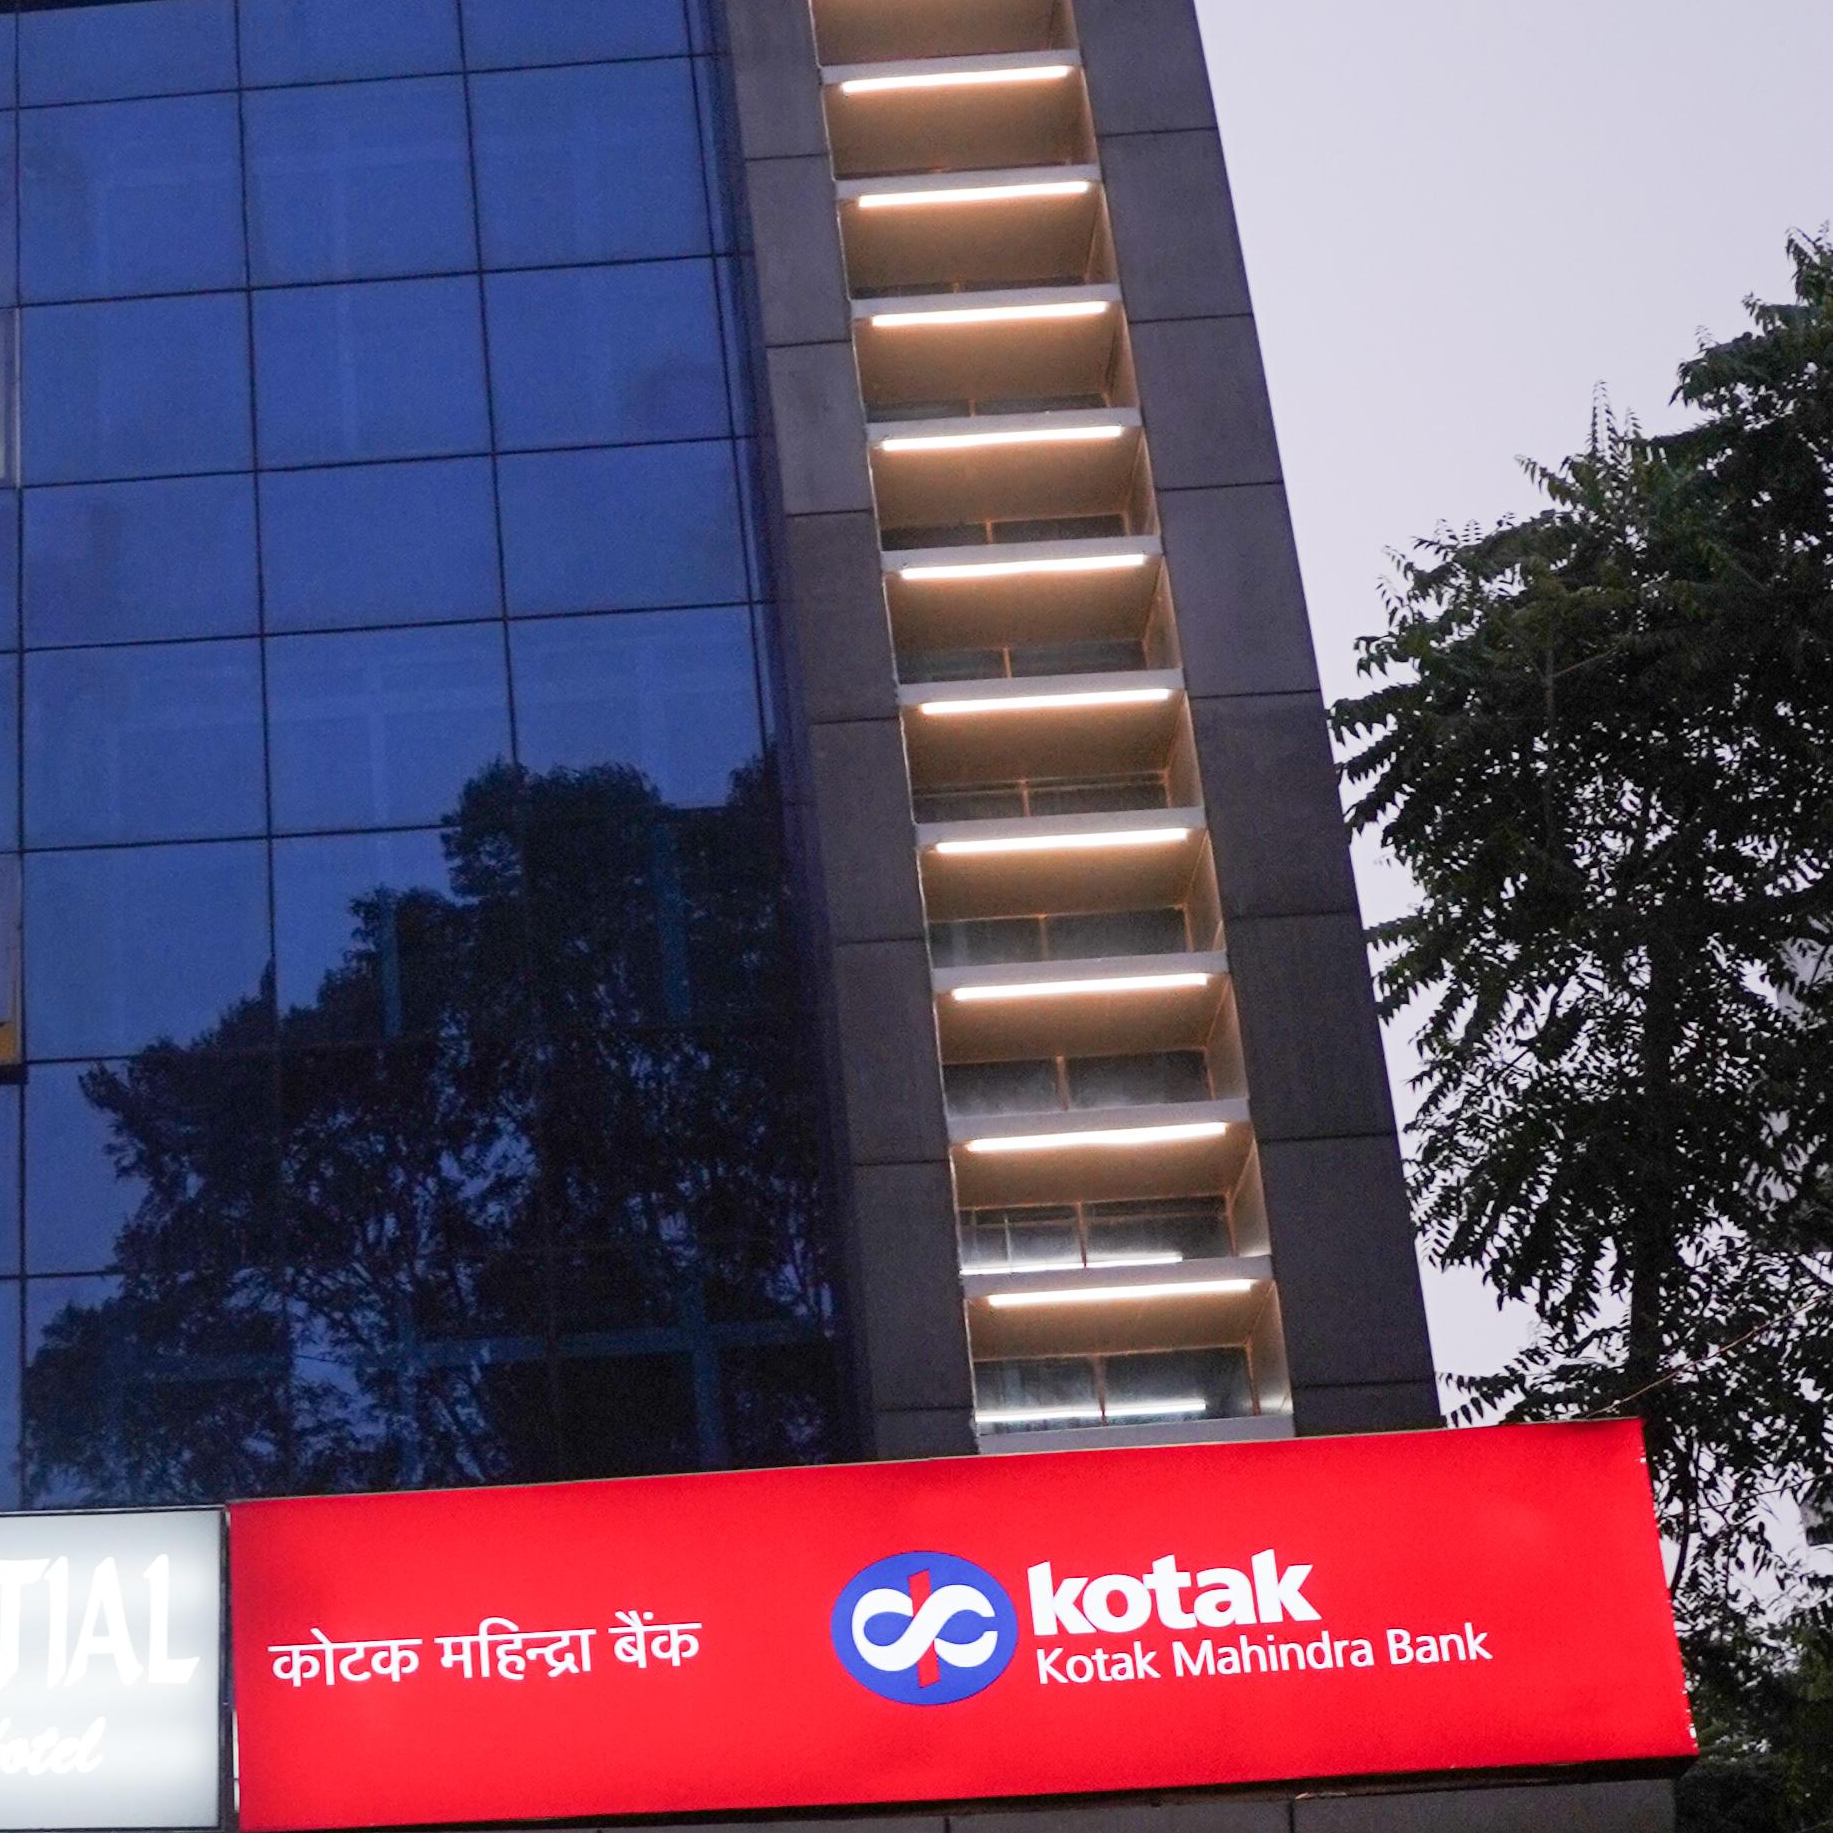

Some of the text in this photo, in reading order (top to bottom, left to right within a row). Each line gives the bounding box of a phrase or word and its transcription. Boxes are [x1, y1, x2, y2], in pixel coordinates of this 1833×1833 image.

[1027, 1548, 1322, 1636] kotak
[267, 1610, 703, 1687] कोटक महिन्द्रा बैंक
[1037, 1622, 1494, 1685] Kotak Mahindra Bank
